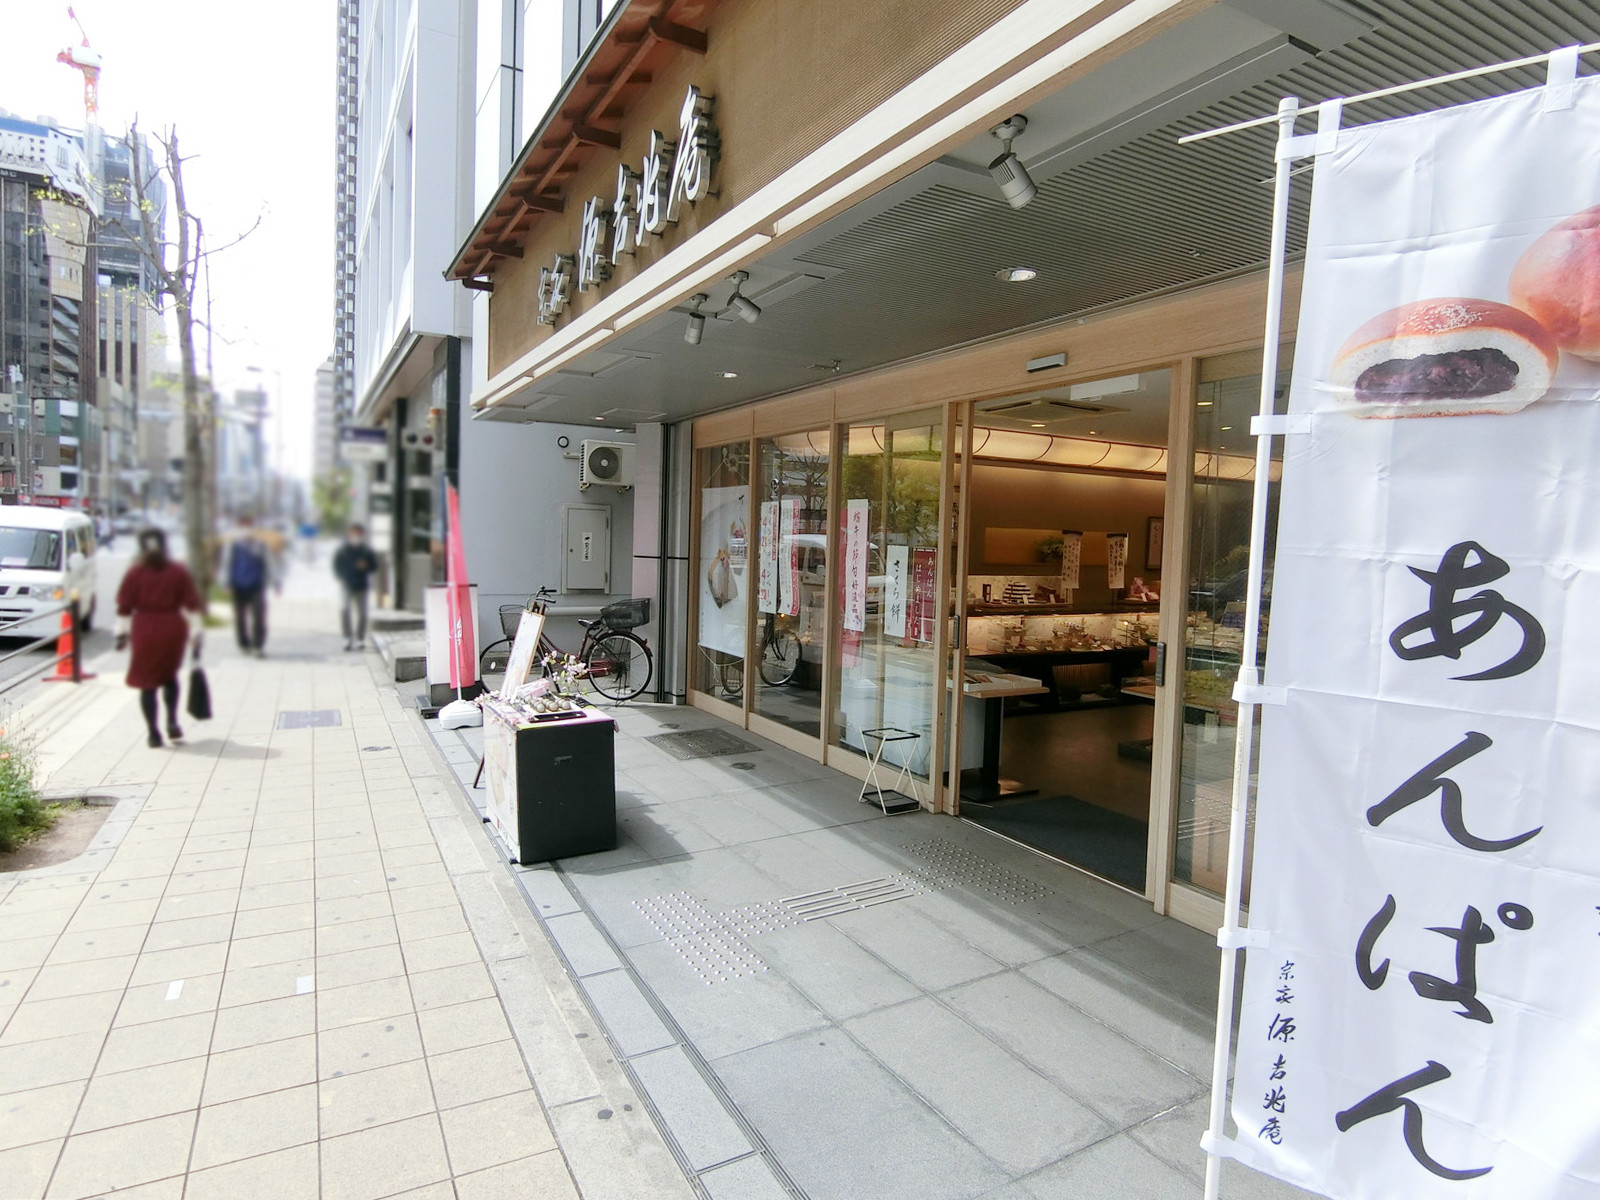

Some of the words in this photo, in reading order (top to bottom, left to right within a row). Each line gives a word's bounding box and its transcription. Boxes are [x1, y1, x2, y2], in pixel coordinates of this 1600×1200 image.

[890, 559, 901, 624] さくら餅
[1335, 540, 1546, 1181] あんぱん
